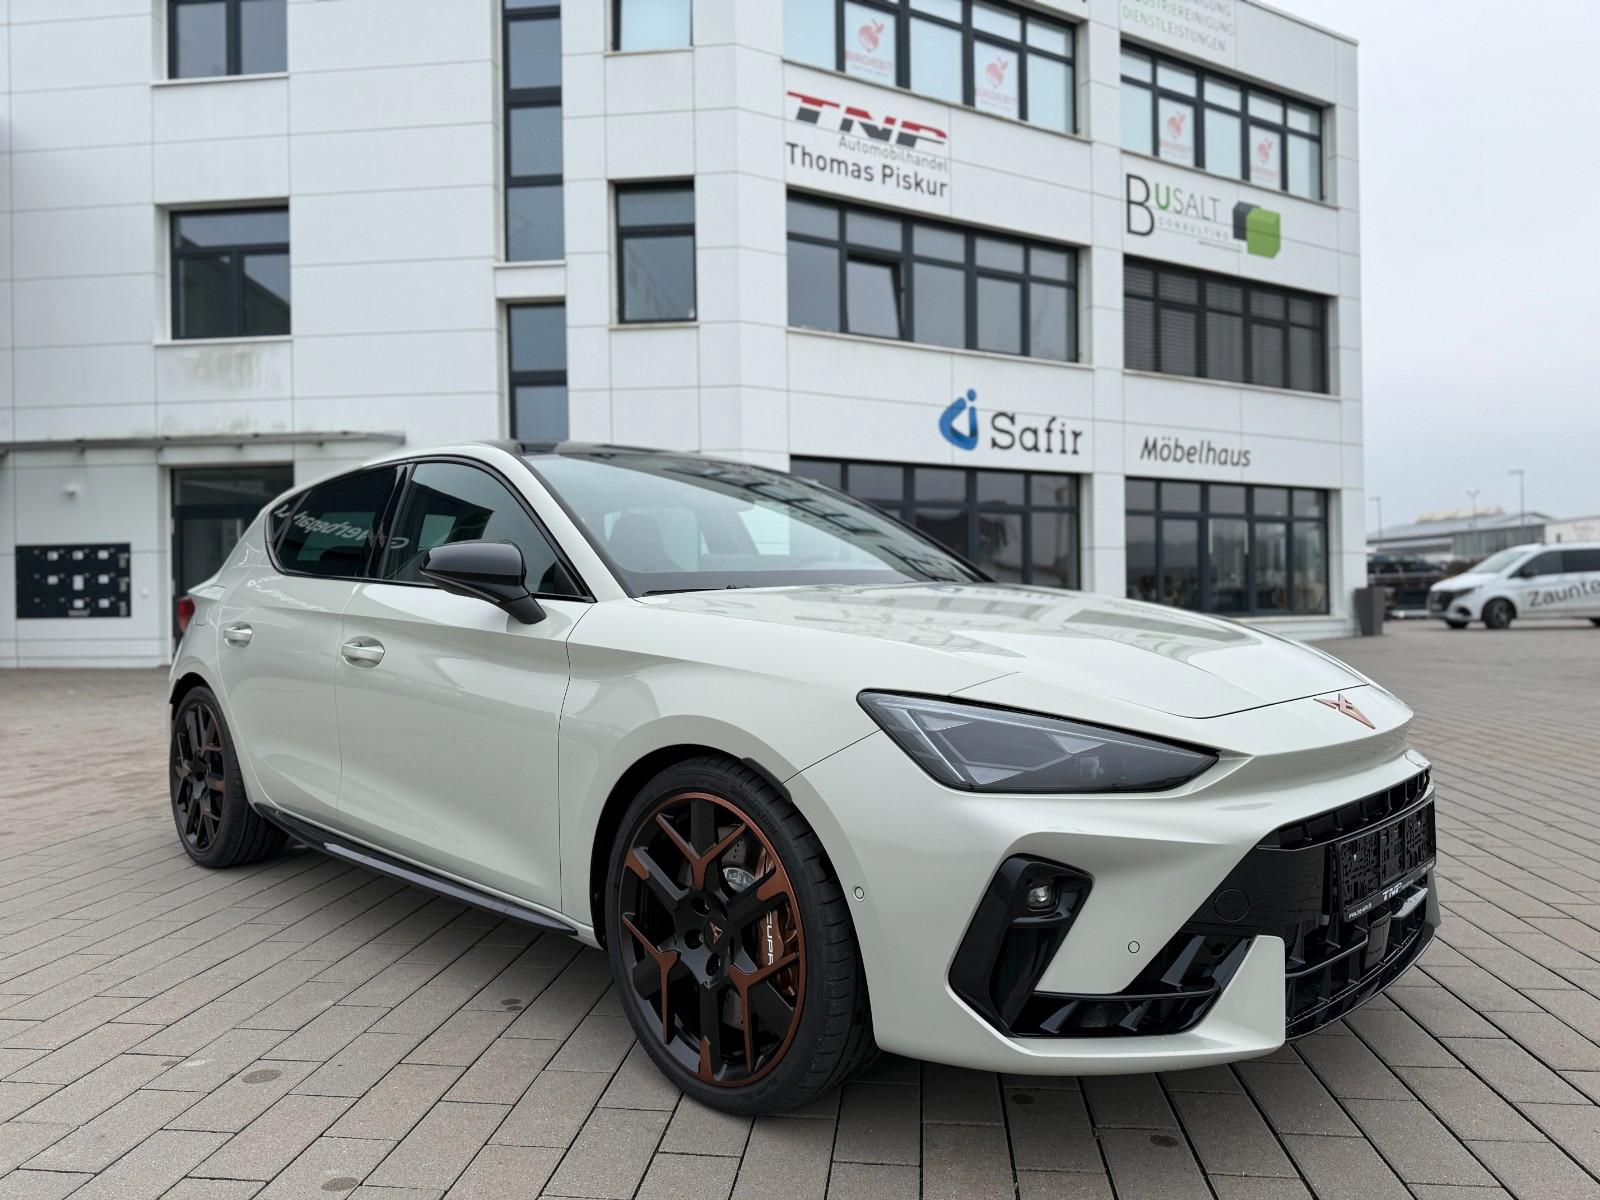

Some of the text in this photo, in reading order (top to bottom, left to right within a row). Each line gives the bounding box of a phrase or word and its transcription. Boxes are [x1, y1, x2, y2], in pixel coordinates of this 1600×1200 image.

[1122, 5, 1226, 51] DIENSTLEISTUNGEN
[787, 91, 947, 148] TNP
[786, 141, 948, 198] Thomas Piskur
[839, 135, 948, 173] Automobilhandel
[1126, 173, 1221, 236] BUSALT
[1158, 216, 1230, 241] CONSULTING
[990, 411, 1083, 455] Safir
[1140, 435, 1252, 467] Möbelhaus
[1527, 579, 1600, 608] Zaunte
[766, 910, 774, 967] CUPR
